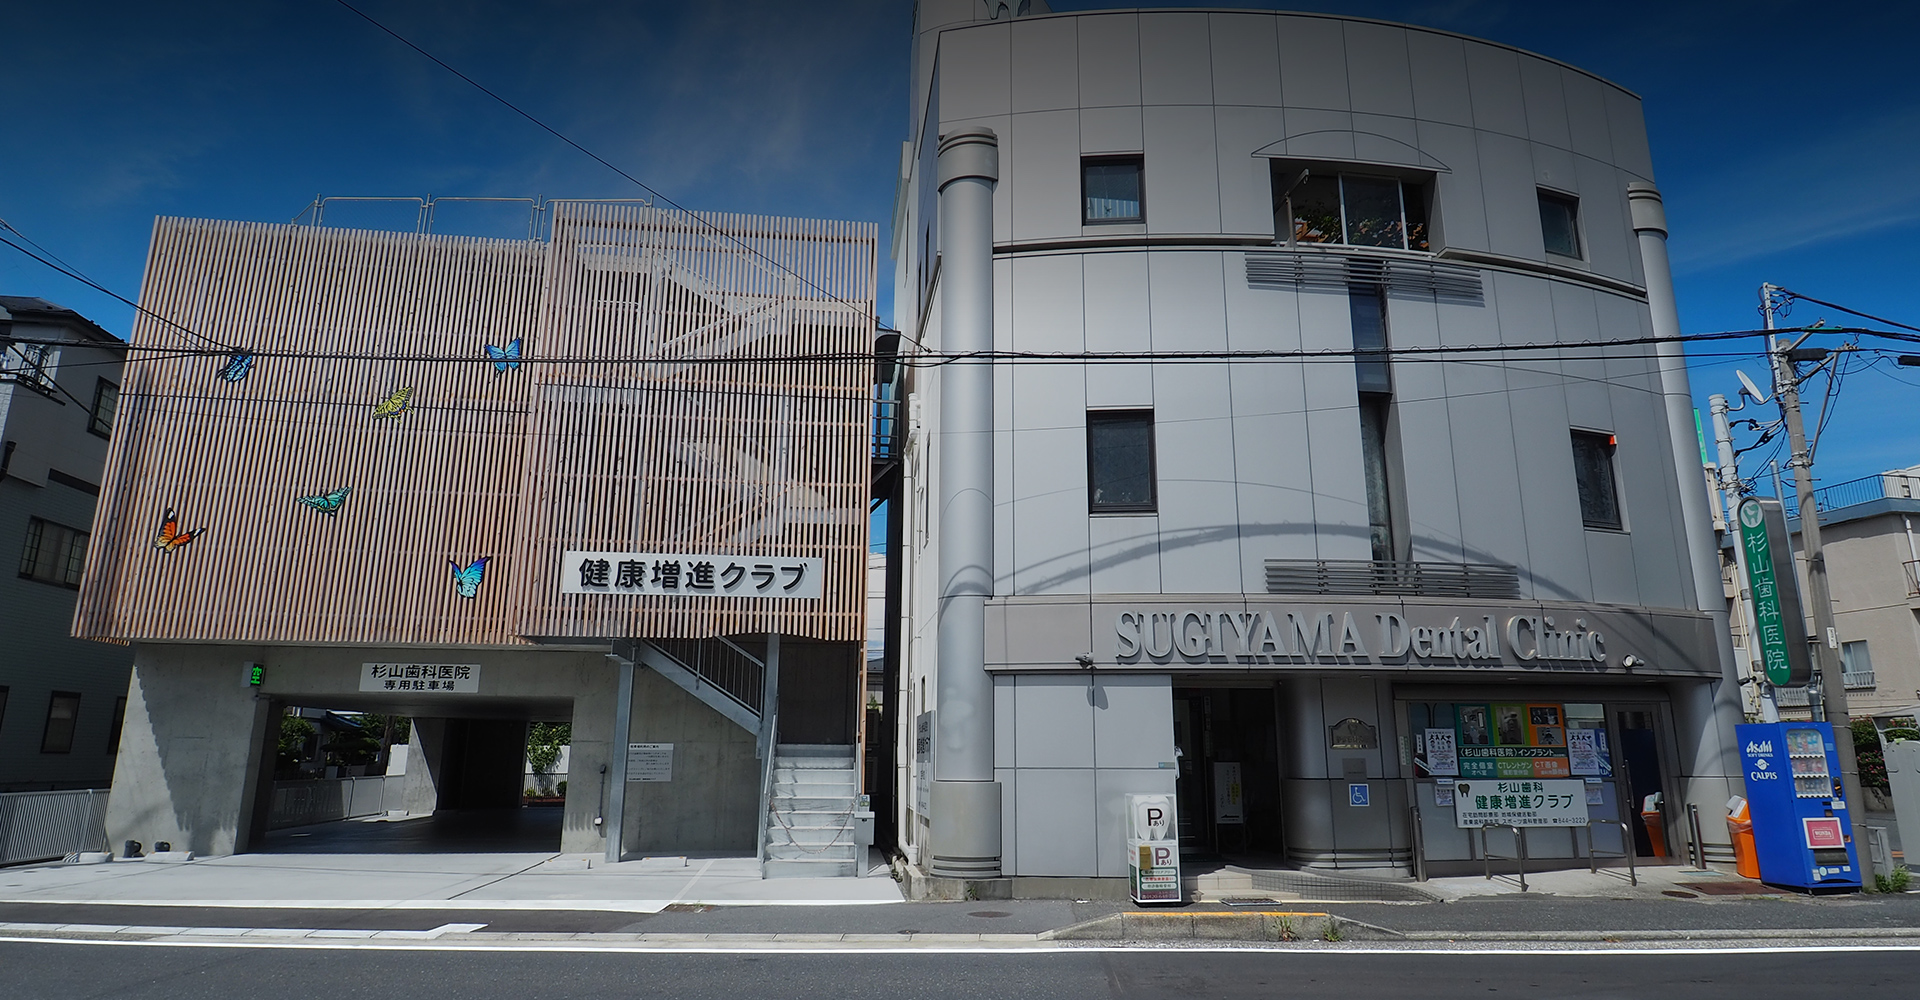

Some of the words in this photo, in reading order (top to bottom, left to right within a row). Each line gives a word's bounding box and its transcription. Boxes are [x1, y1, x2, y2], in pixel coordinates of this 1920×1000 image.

[578, 557, 808, 591] 健康増進クラブ
[1747, 531, 1788, 670] 杉山歯科医院
[1115, 610, 1370, 659] SUGIYAMA
[1375, 611, 1503, 659] Dental
[1507, 614, 1607, 663] Clinic
[250, 666, 263, 685] 空
[371, 664, 471, 680] 杉山歯科医院
[384, 680, 456, 691] 専用駐車場
[1746, 740, 1773, 753] Asahi
[1751, 771, 1778, 781] CALPIS
[1498, 782, 1544, 794] 杉山歯科
[1475, 795, 1574, 810] 健康増進クラブ
